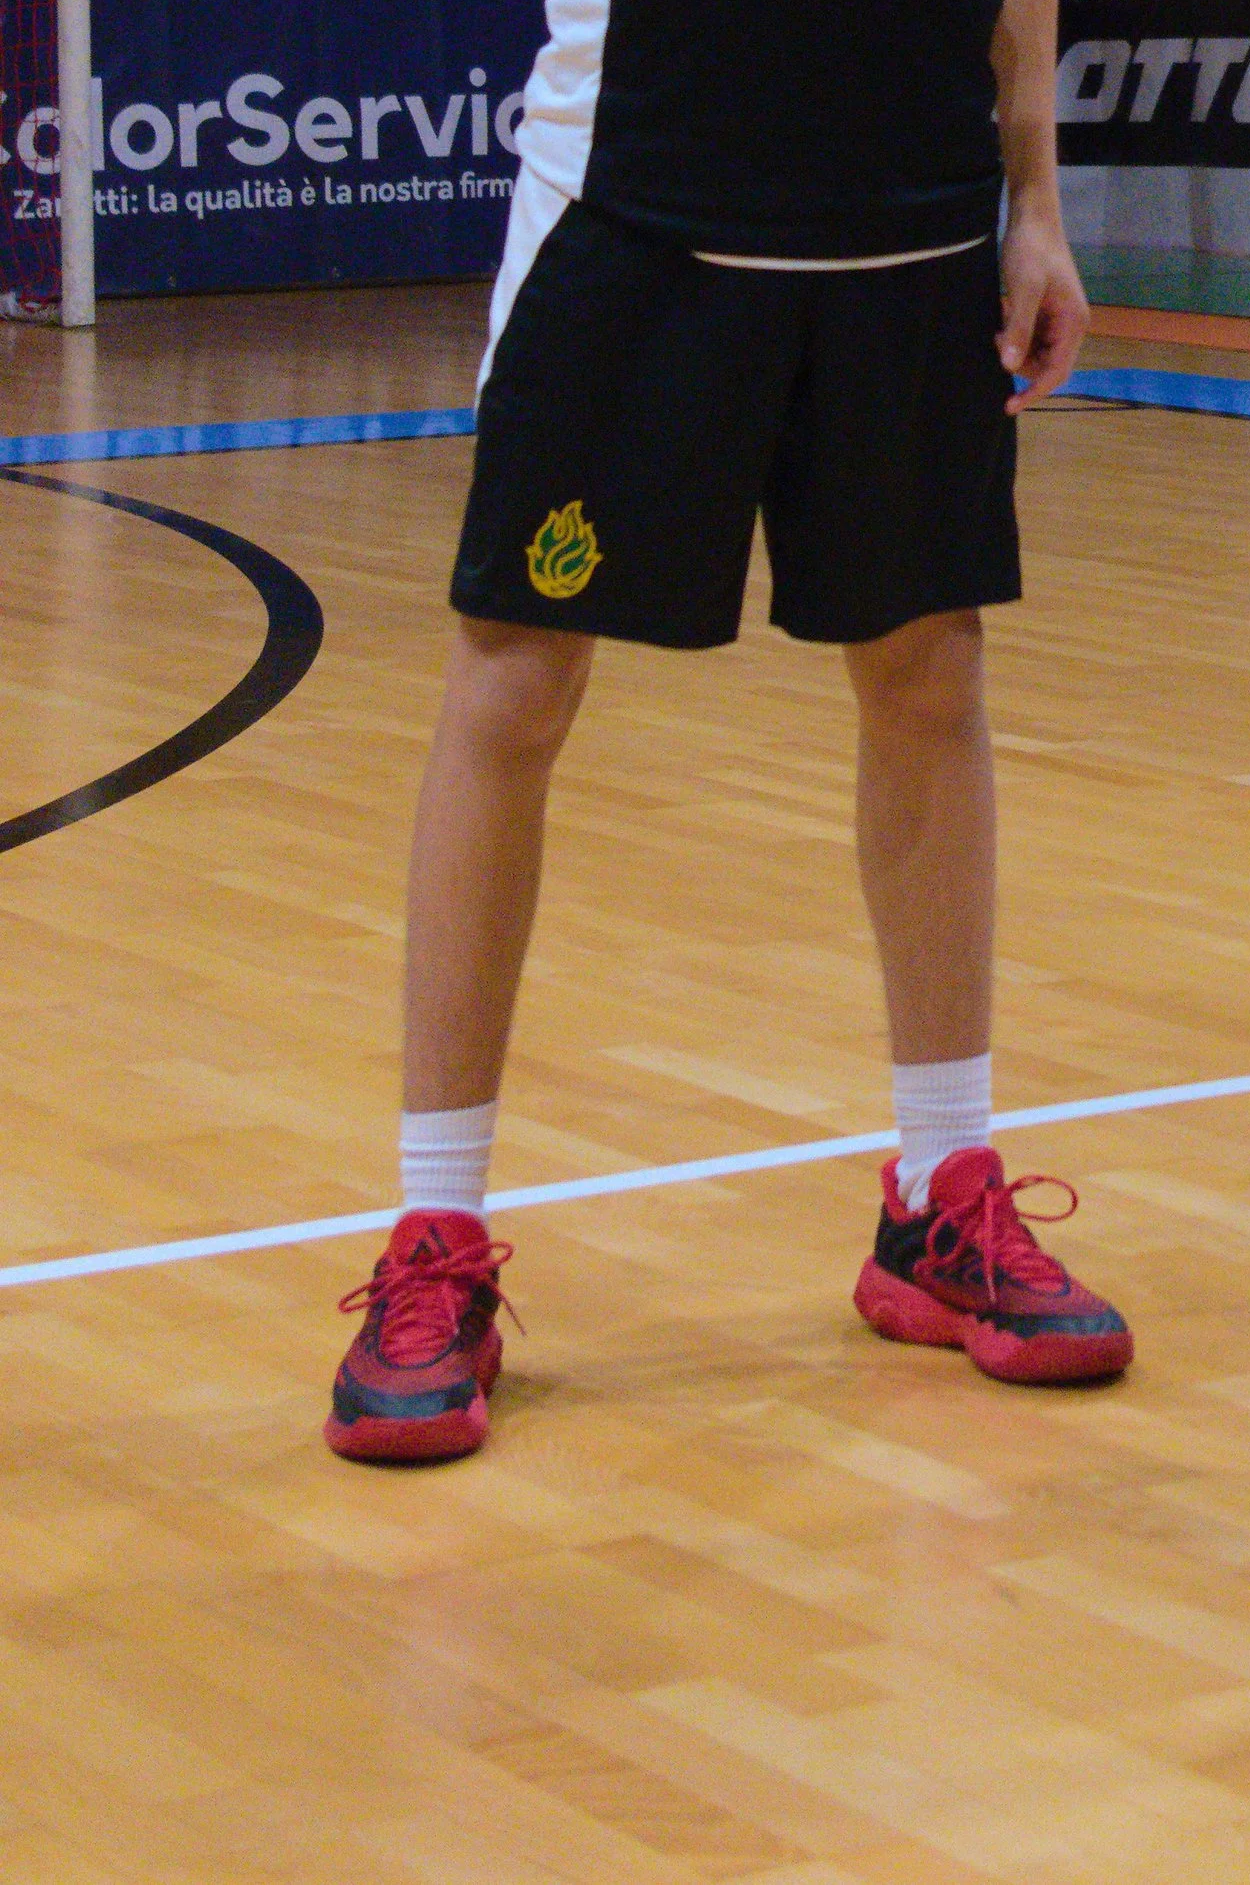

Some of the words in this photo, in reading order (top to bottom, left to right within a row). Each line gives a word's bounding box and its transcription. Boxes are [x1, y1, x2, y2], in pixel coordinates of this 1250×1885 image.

[0, 67, 525, 175] olorServic
[13, 185, 139, 220] Zatti:
[147, 183, 179, 214] la
[185, 178, 294, 220] qualità
[300, 176, 317, 207] è
[324, 176, 352, 206] la
[360, 175, 454, 204] nostra
[460, 170, 514, 199] firm
